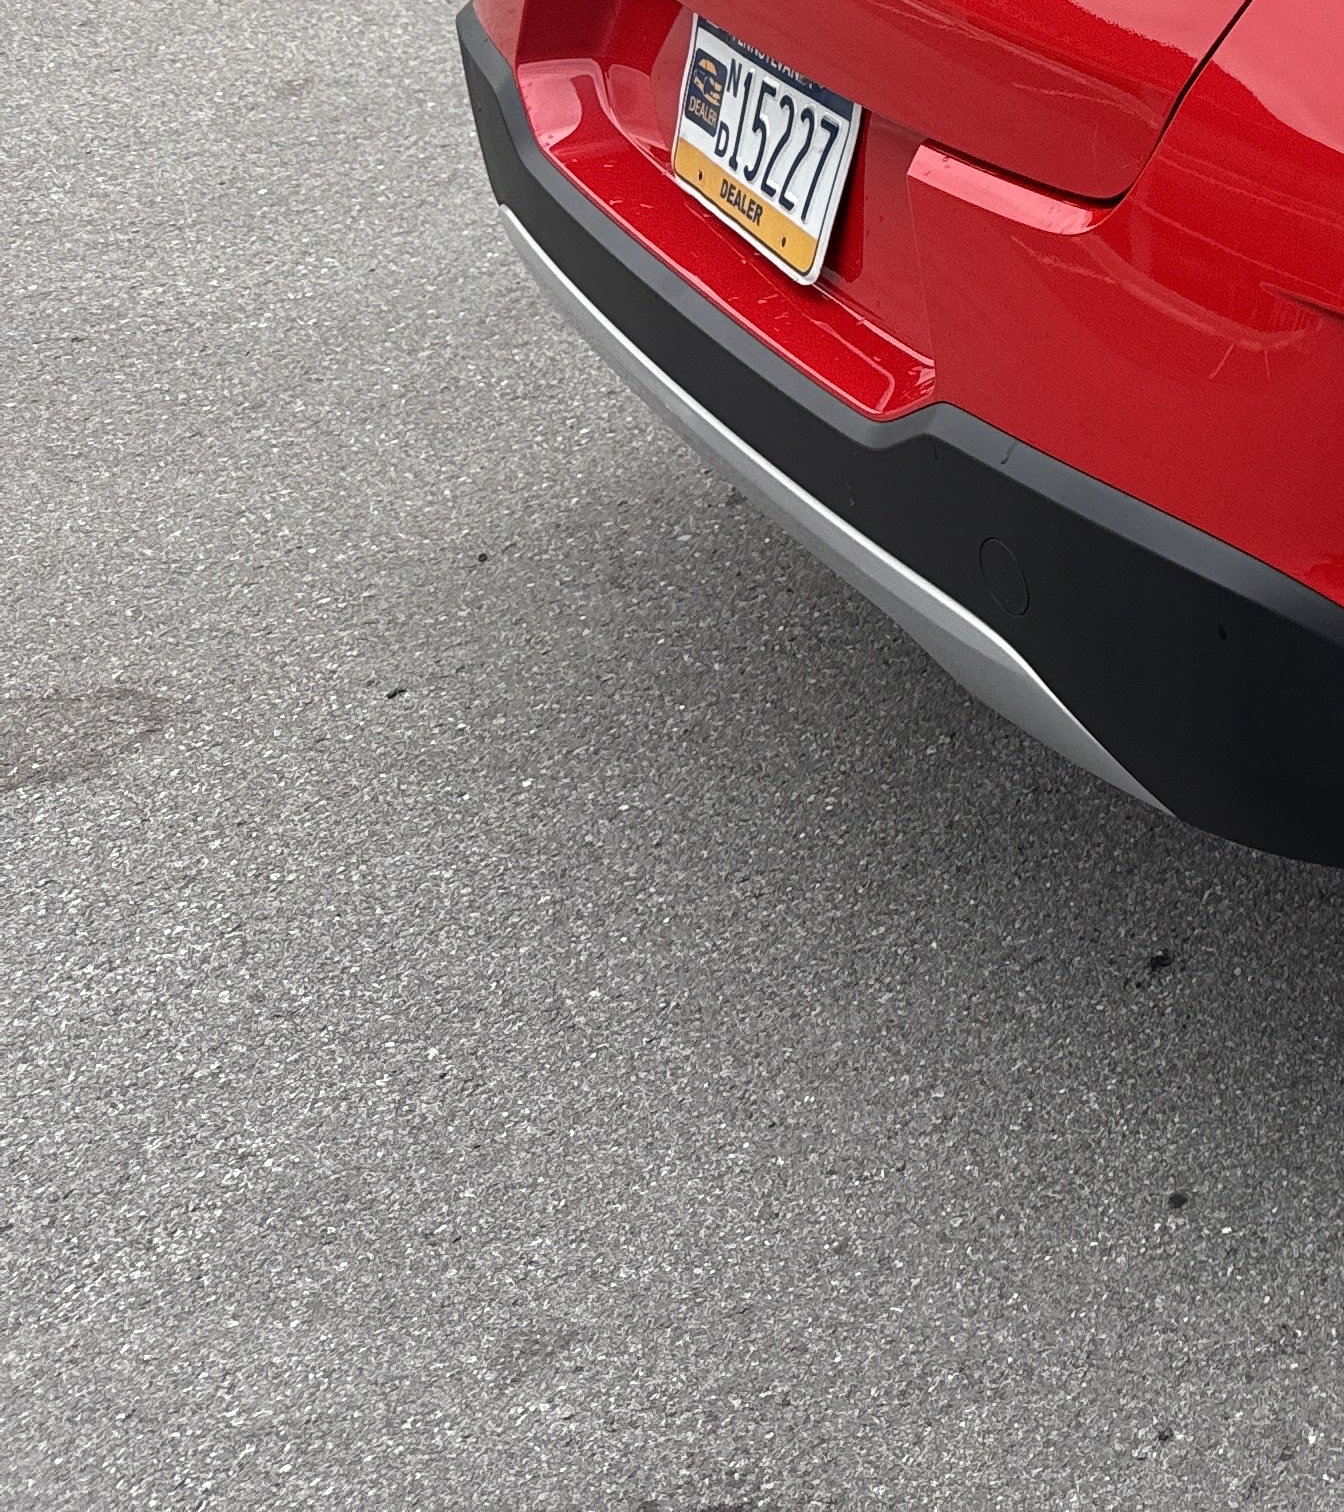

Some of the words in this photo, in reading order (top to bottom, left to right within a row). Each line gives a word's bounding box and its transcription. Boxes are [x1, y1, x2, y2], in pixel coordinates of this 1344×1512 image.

[688, 95, 718, 131] DEALER
[729, 71, 840, 222] 15227
[719, 178, 764, 227] DEALER
